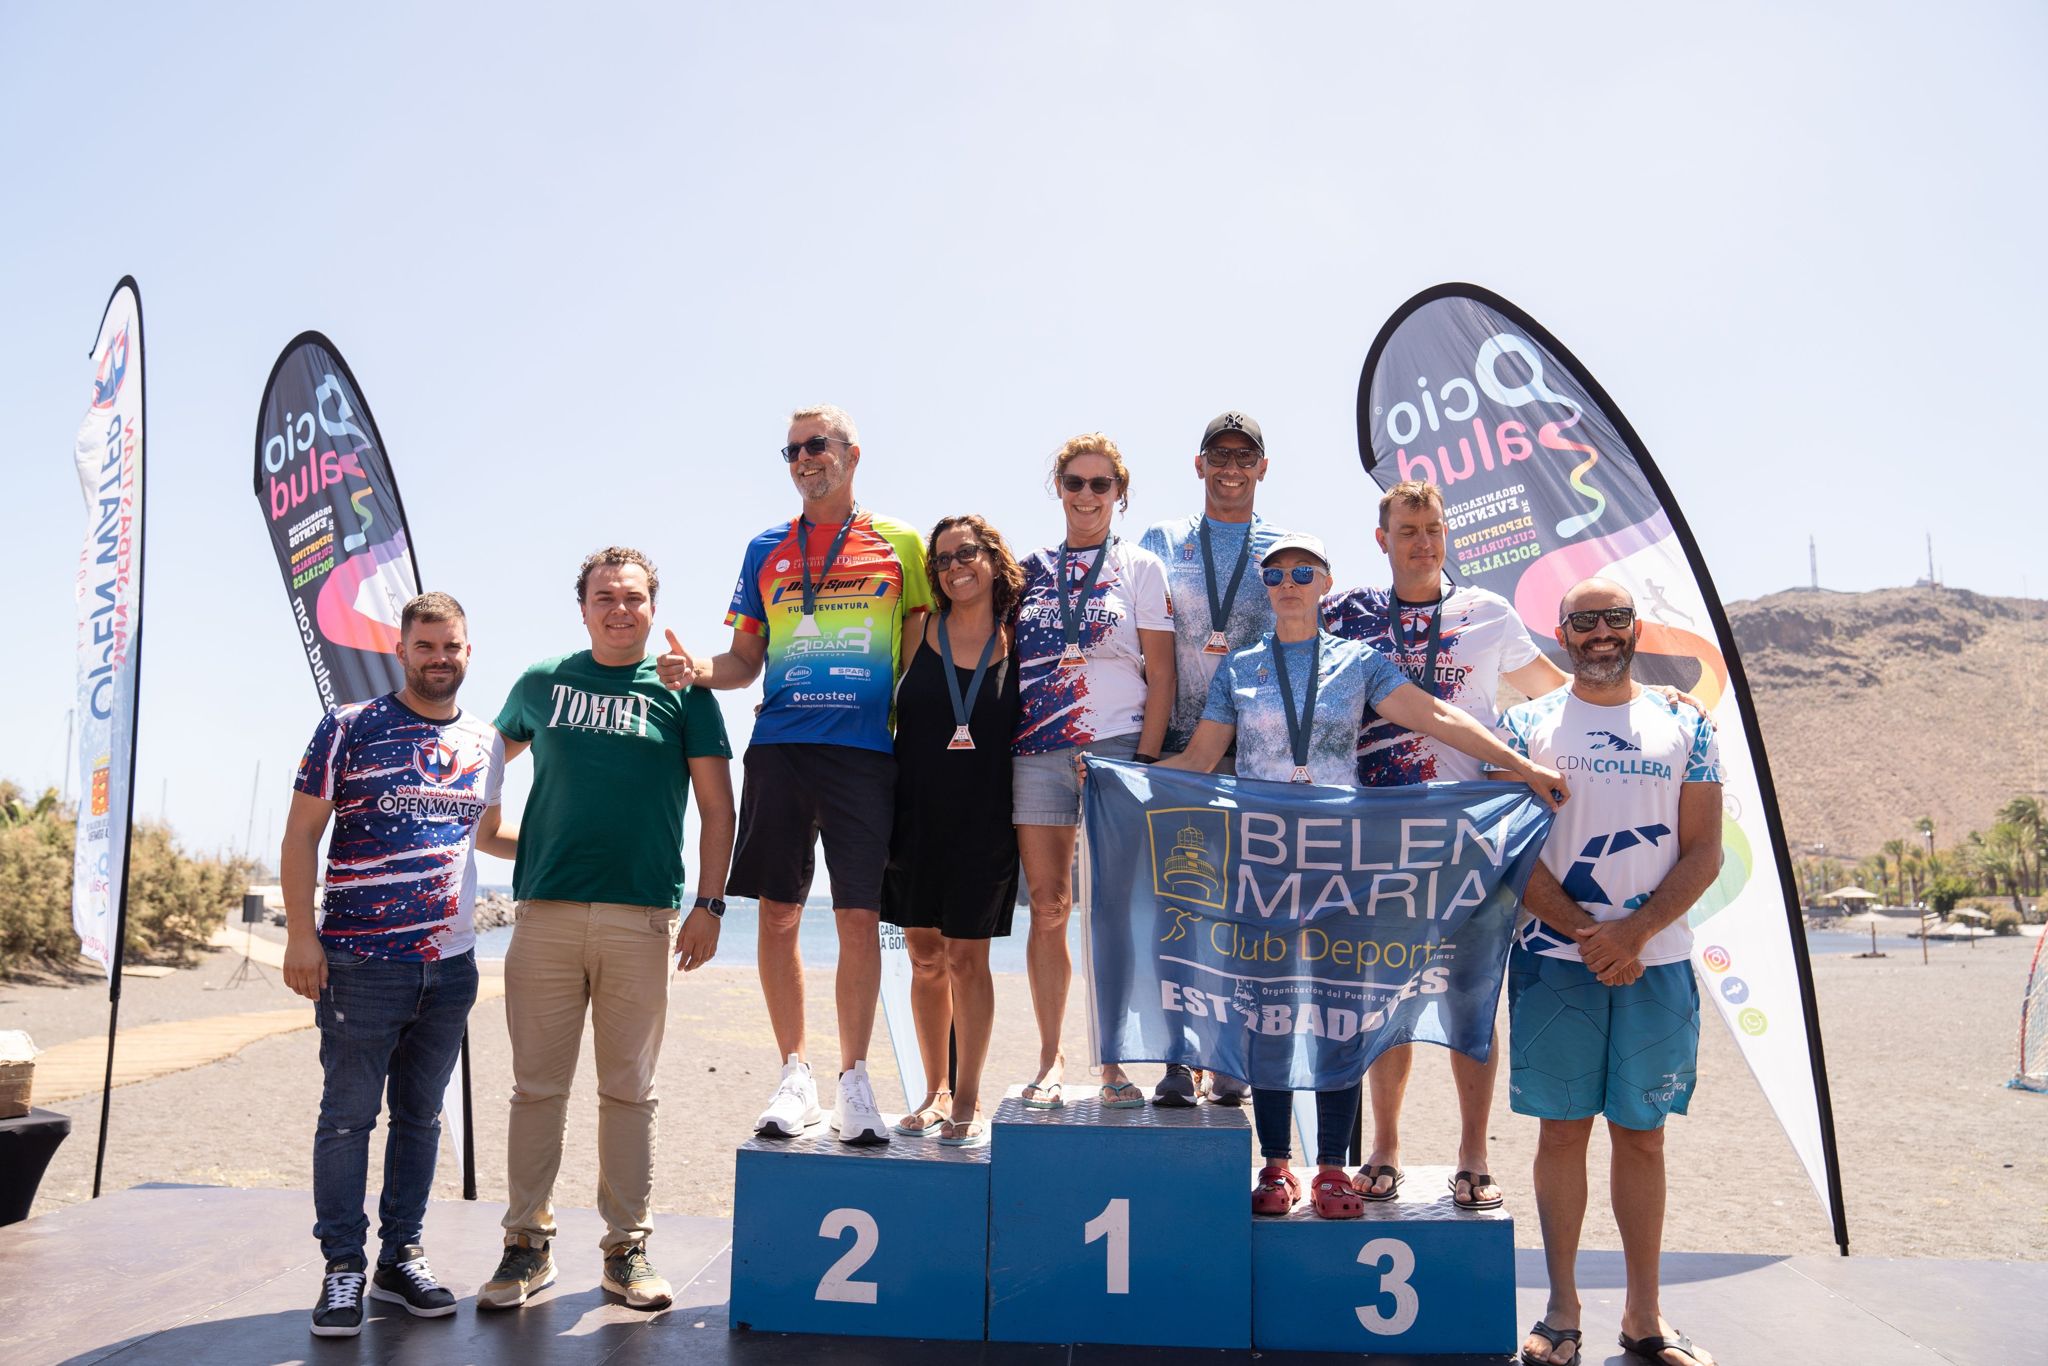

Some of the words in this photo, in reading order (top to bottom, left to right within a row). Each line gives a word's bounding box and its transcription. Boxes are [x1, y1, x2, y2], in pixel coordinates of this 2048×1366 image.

[788, 601, 869, 614] FUETEVENTURA
[824, 577, 869, 593] Sport
[546, 684, 654, 737] TOMMY
[801, 691, 857, 701] ecosteel
[397, 786, 420, 795] SAN
[1240, 811, 1508, 871] BELEN
[1235, 864, 1487, 920] MARIA
[1210, 922, 1287, 963] Club
[1262, 985, 1323, 998] Organización
[1326, 988, 1341, 999] del
[1345, 991, 1376, 1002] Puerto
[814, 1207, 878, 1305] 2
[1083, 1198, 1130, 1294] 1
[1353, 1238, 1419, 1336] 3
